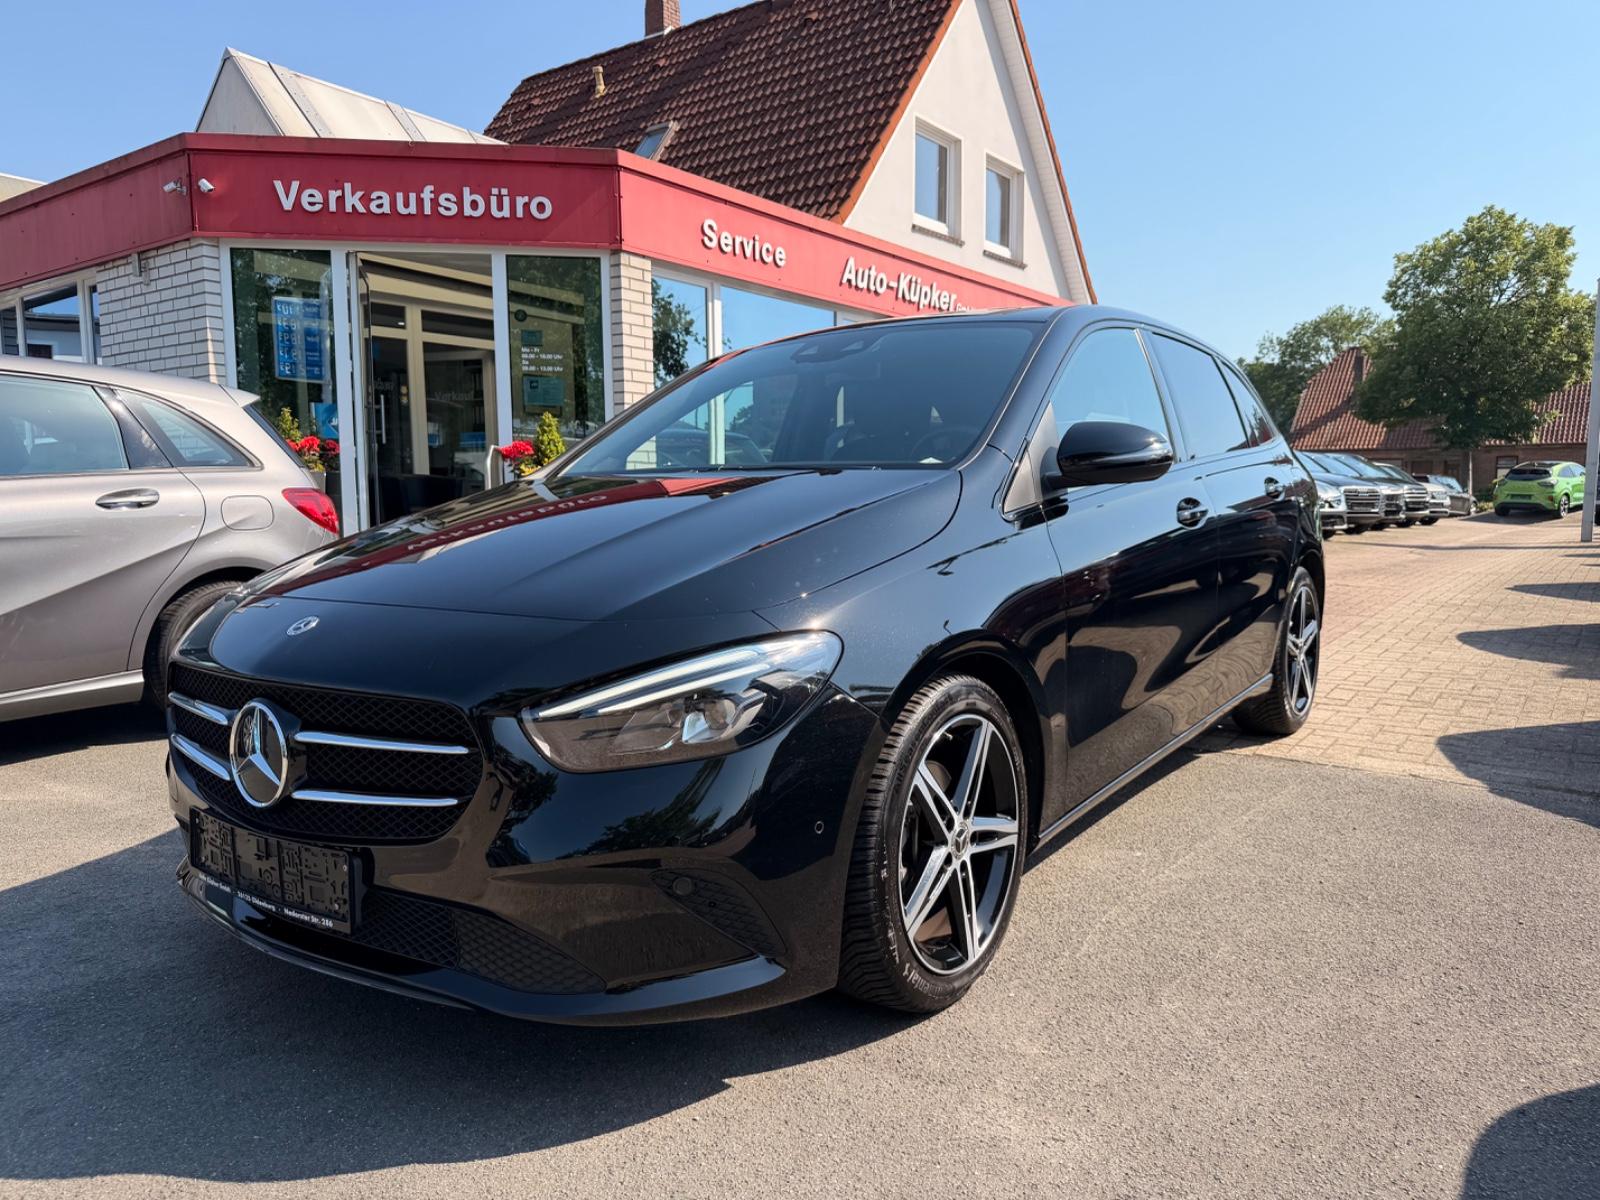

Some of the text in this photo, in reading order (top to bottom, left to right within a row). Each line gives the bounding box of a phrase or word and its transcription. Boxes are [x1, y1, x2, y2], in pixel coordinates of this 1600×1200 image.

[273, 180, 553, 220] Verkaufsbüro
[702, 219, 786, 267] Service
[841, 256, 957, 312] Auto-Küpker
